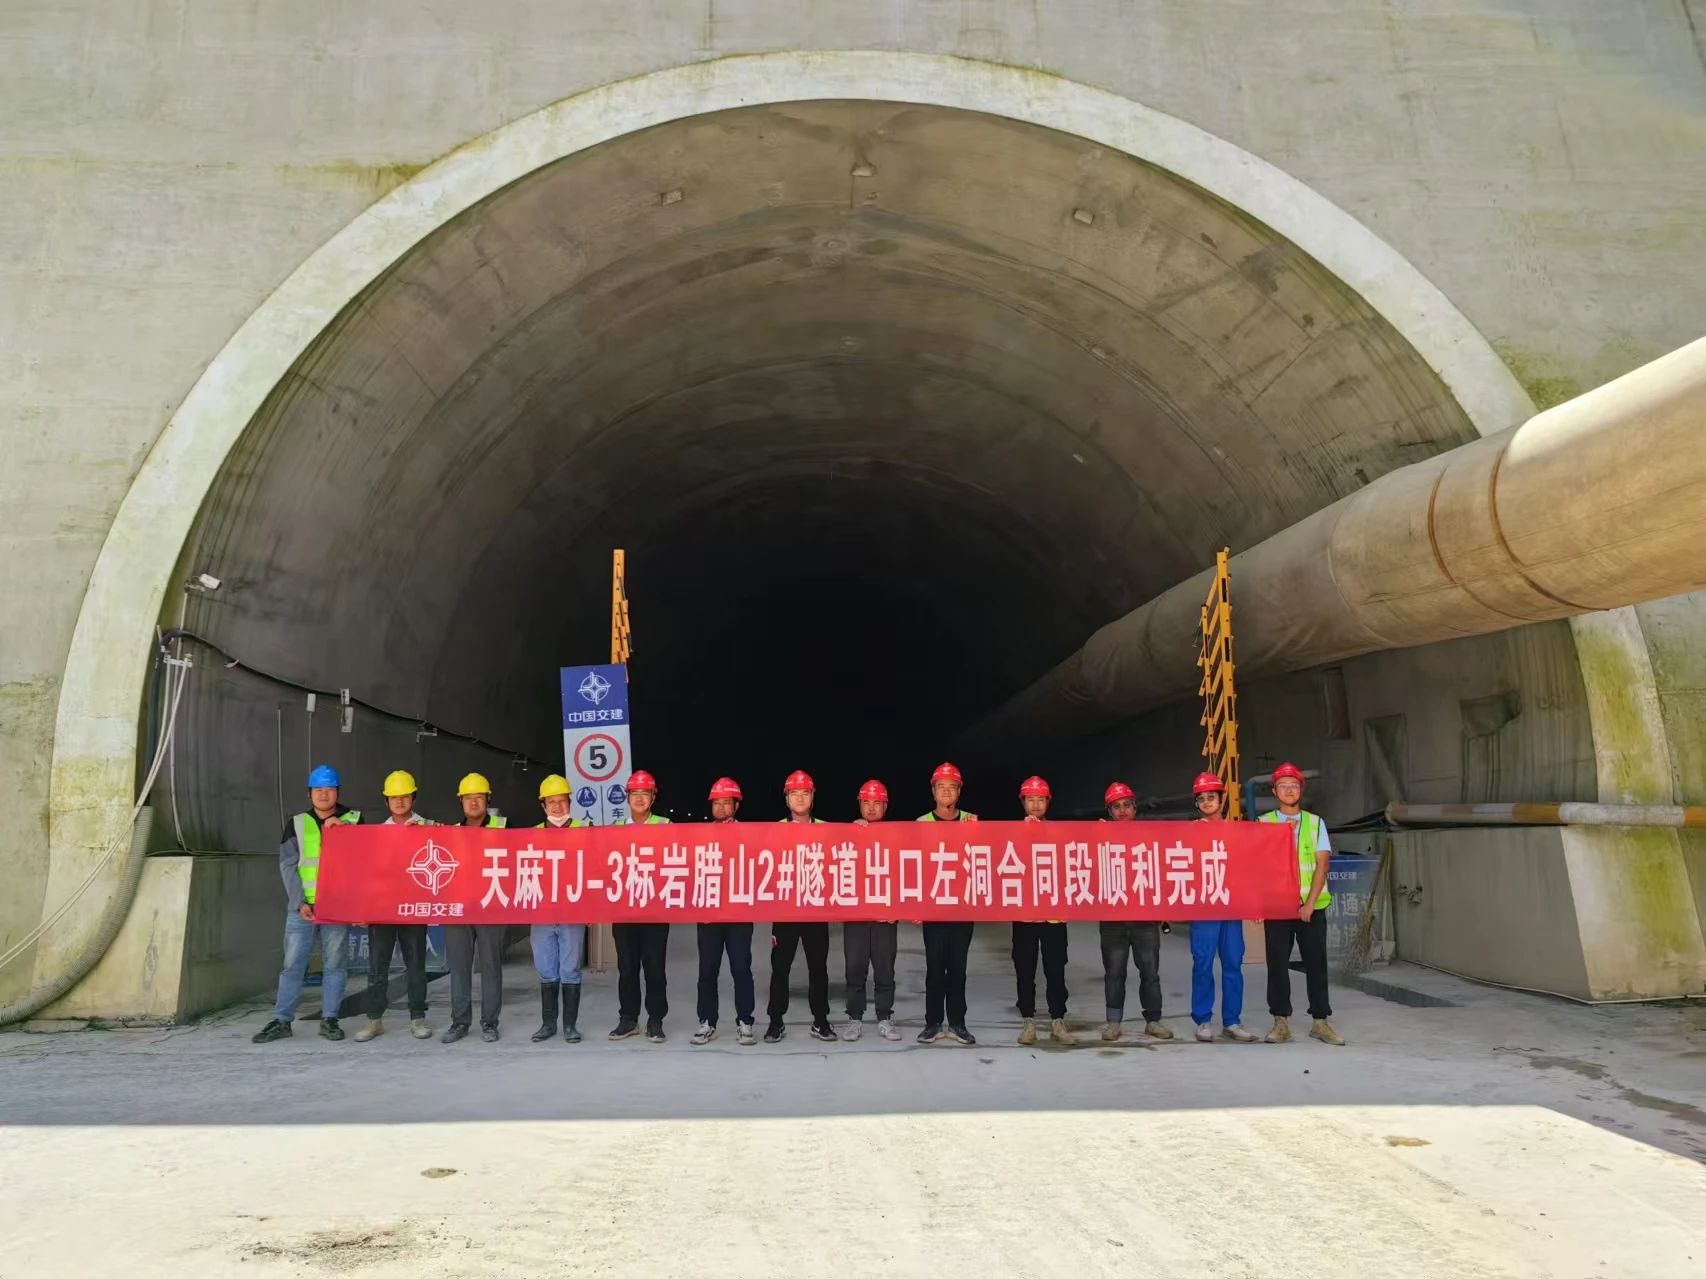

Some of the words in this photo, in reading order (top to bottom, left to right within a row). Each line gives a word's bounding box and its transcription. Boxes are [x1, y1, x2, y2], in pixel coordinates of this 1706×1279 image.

[568, 709, 624, 722] 中国交建
[590, 745, 608, 770] 5
[612, 808, 624, 818] 车
[481, 841, 1230, 908] 天麻TJ-3标岩腊山2#隧道出口左洞合同段顺利完成
[397, 903, 464, 917] 中国交建
